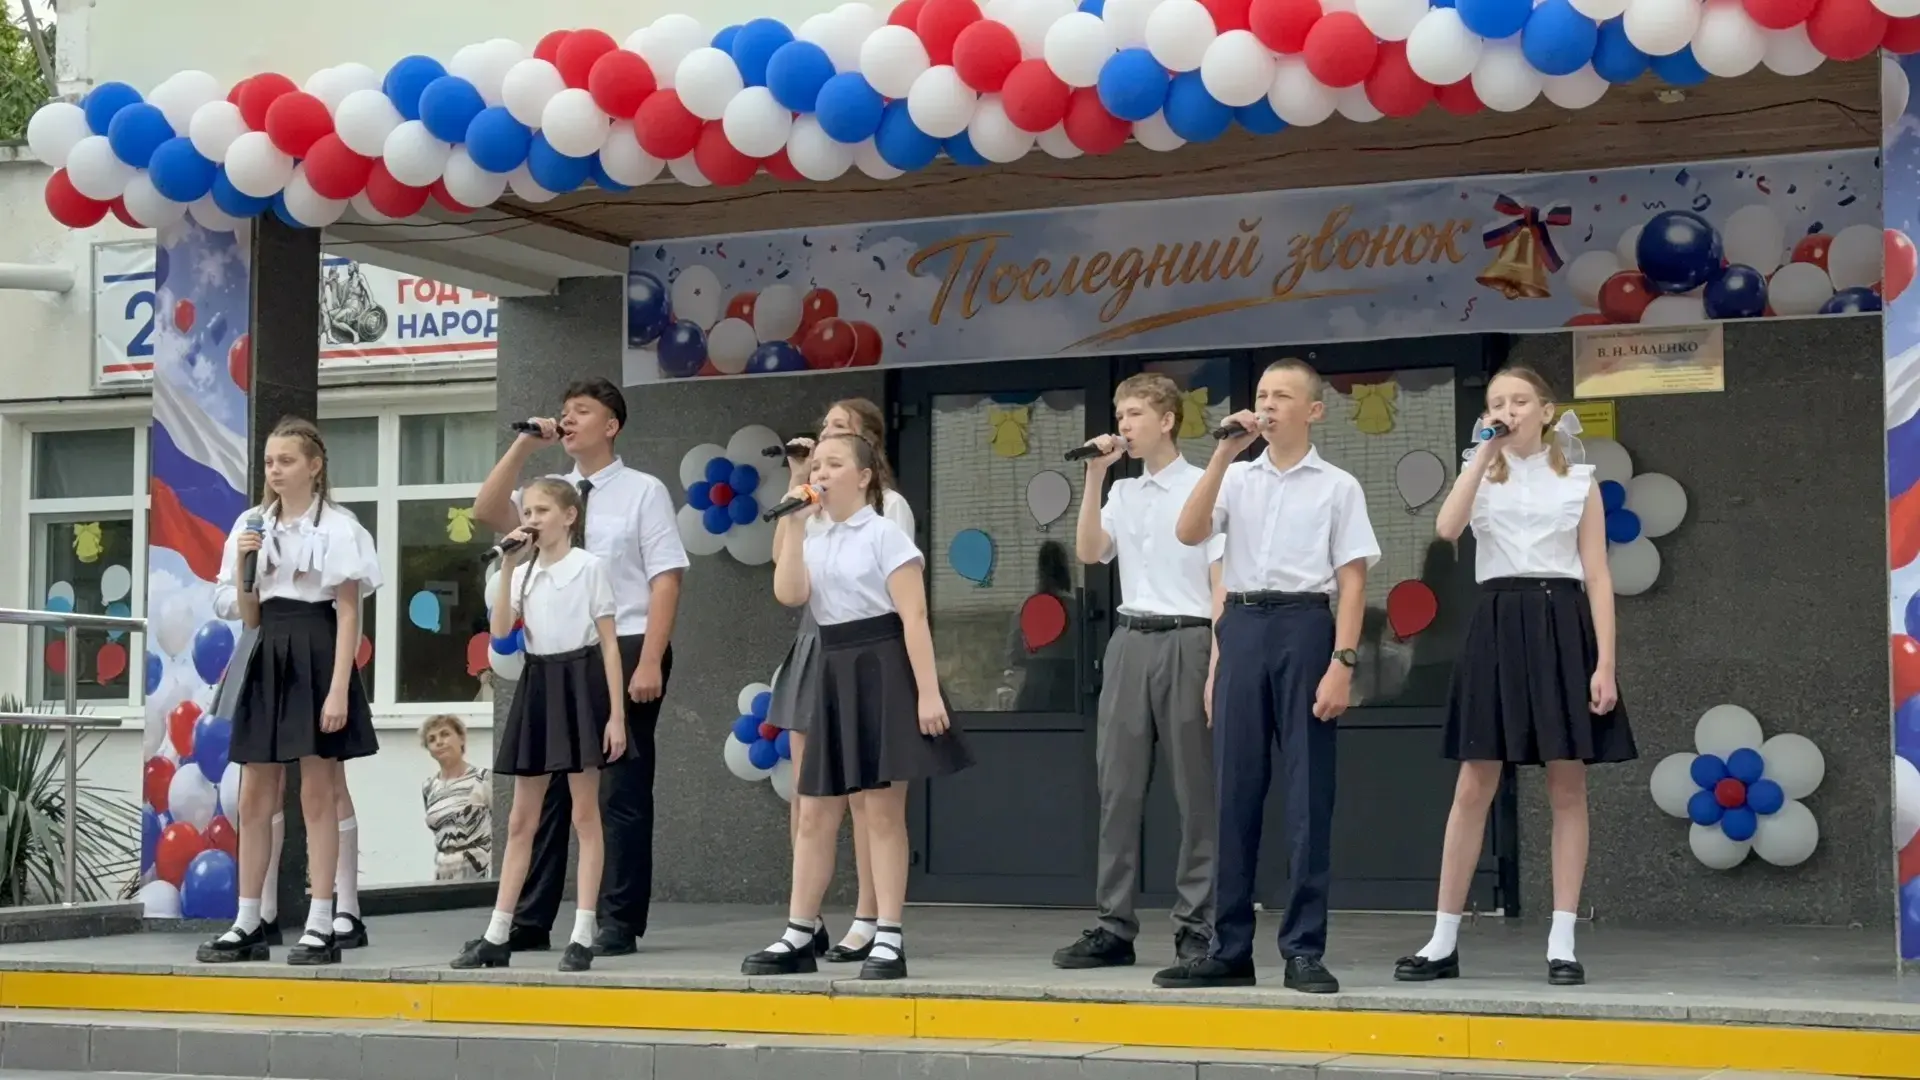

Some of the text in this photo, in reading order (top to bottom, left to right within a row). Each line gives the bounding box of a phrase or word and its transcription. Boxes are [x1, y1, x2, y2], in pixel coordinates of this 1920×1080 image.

[907, 205, 1474, 326] Последний звонок
[398, 278, 460, 306] ГОД
[1597, 341, 1699, 358] В. Н. ЧАЛЕНКО
